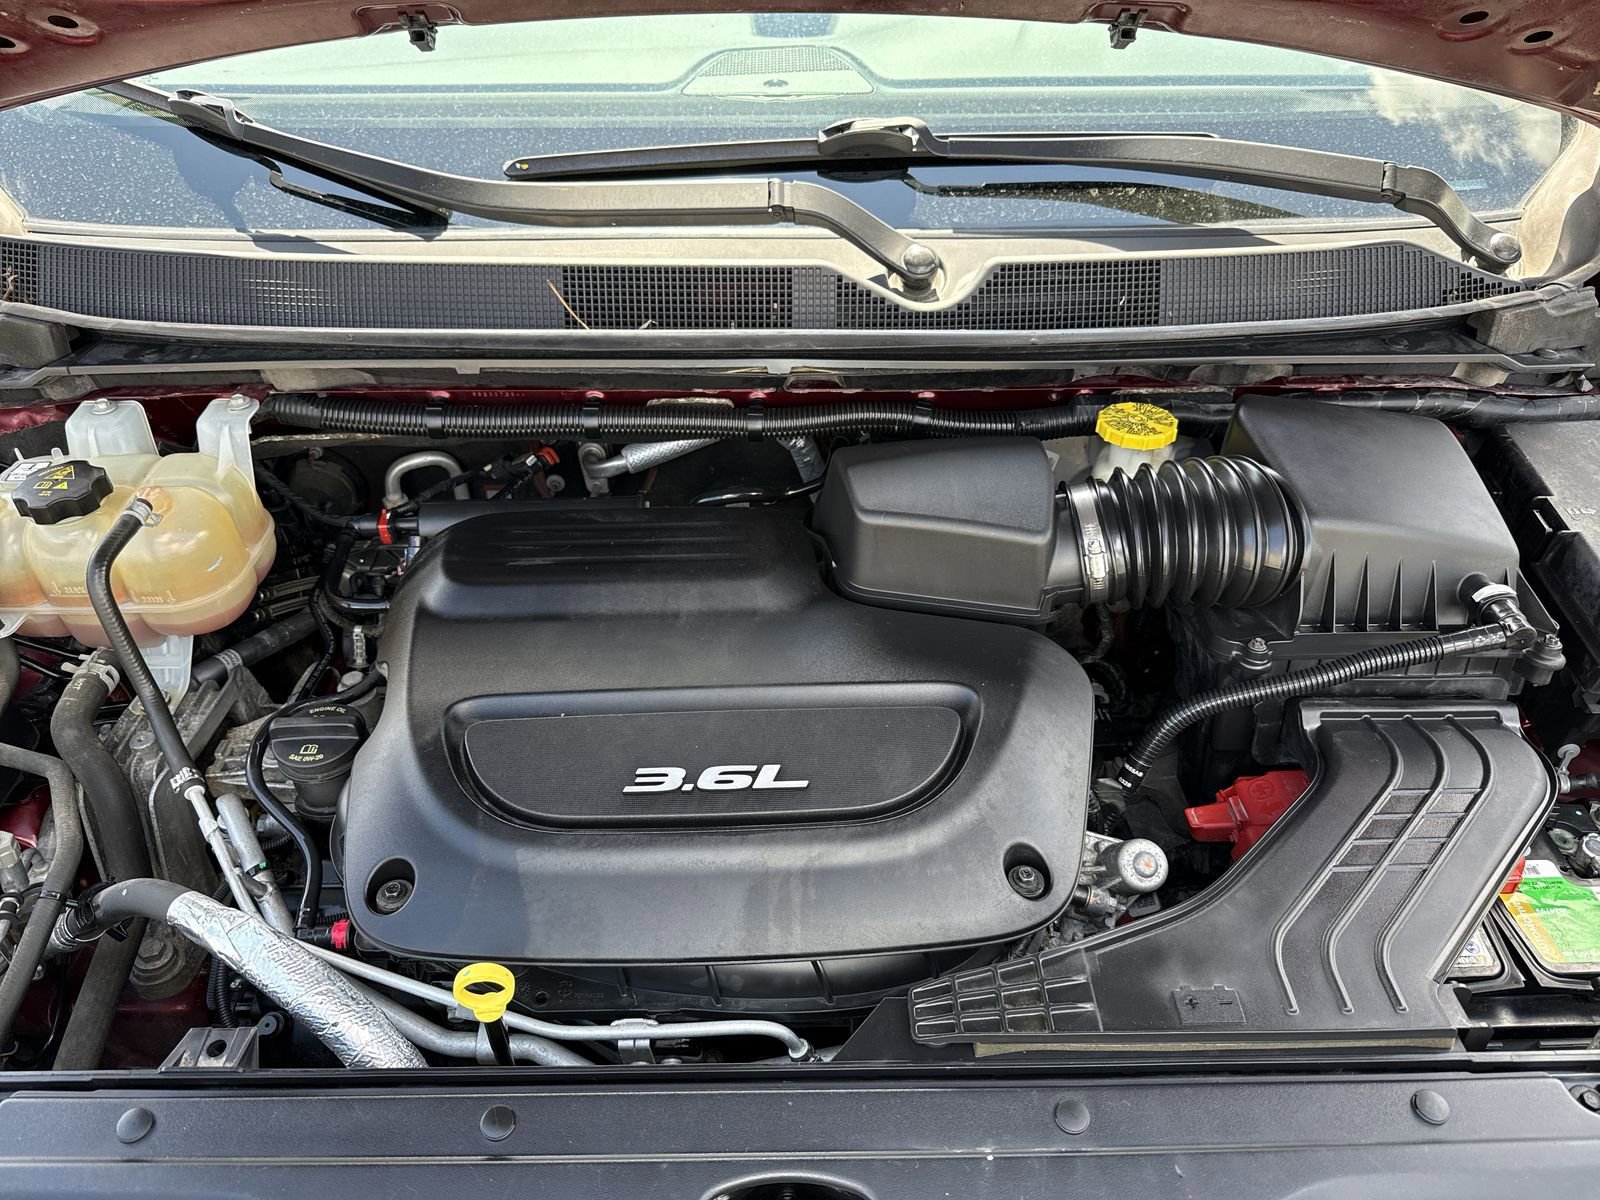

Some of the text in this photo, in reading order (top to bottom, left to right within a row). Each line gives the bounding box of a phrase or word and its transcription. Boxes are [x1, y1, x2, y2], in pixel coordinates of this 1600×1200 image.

[309, 706, 347, 714] ENGINE OIL
[288, 753, 324, 762] SAE 0W-20
[622, 763, 810, 795] 3.6L
